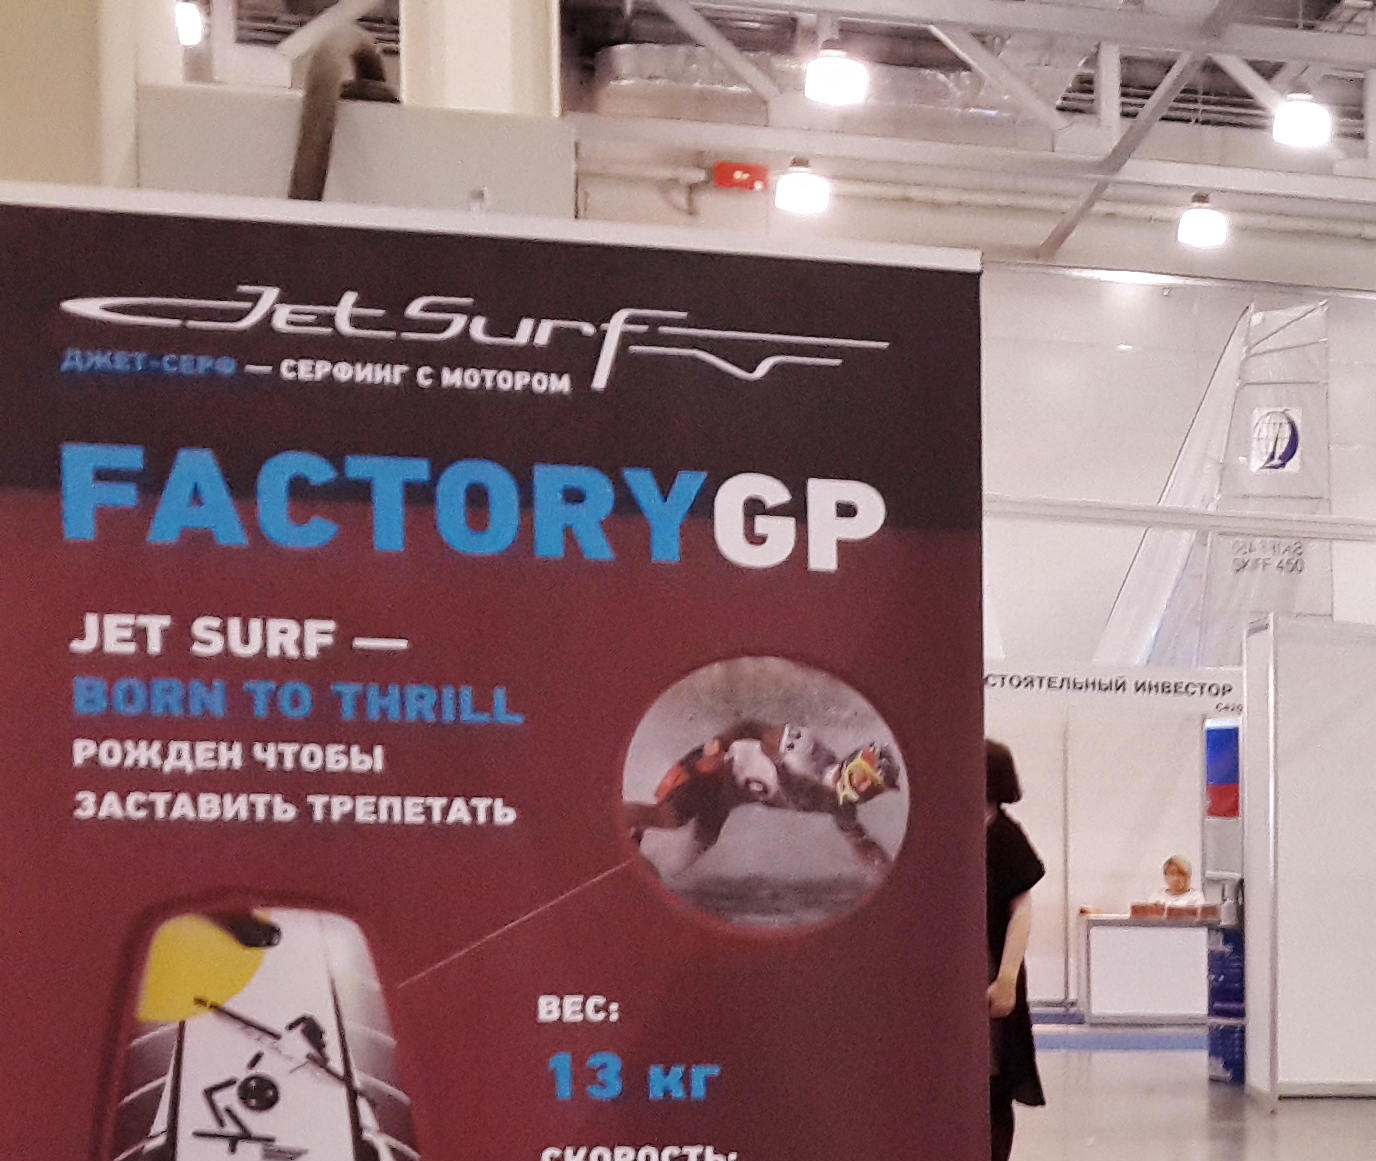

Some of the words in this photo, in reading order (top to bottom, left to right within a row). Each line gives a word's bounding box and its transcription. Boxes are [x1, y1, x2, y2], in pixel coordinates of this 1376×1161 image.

[60, 350, 237, 376] ДЖЕТ-СЕРФ
[280, 359, 409, 384] СЕРФИНГ
[417, 367, 432, 386] С
[442, 366, 571, 393] МОТОРОМ
[70, 613, 171, 654] JET
[192, 616, 336, 658] SURF
[74, 676, 227, 717] BORN
[244, 680, 313, 719] TO
[332, 682, 524, 725] THRILL
[984, 672, 1127, 693] СТОЯТЕЛЬНЫЙ
[1133, 680, 1233, 697] ИНВЕСТОР
[74, 739, 242, 773] РОЖДЕН
[254, 742, 383, 772] ЧТОБЫ
[74, 791, 296, 821] ЗАСТАВИТЬ
[307, 795, 516, 825] ТРЕПЕТАТЬ
[538, 995, 619, 1022] ВЕС:
[549, 1051, 625, 1101] 13
[648, 1065, 721, 1101] кг
